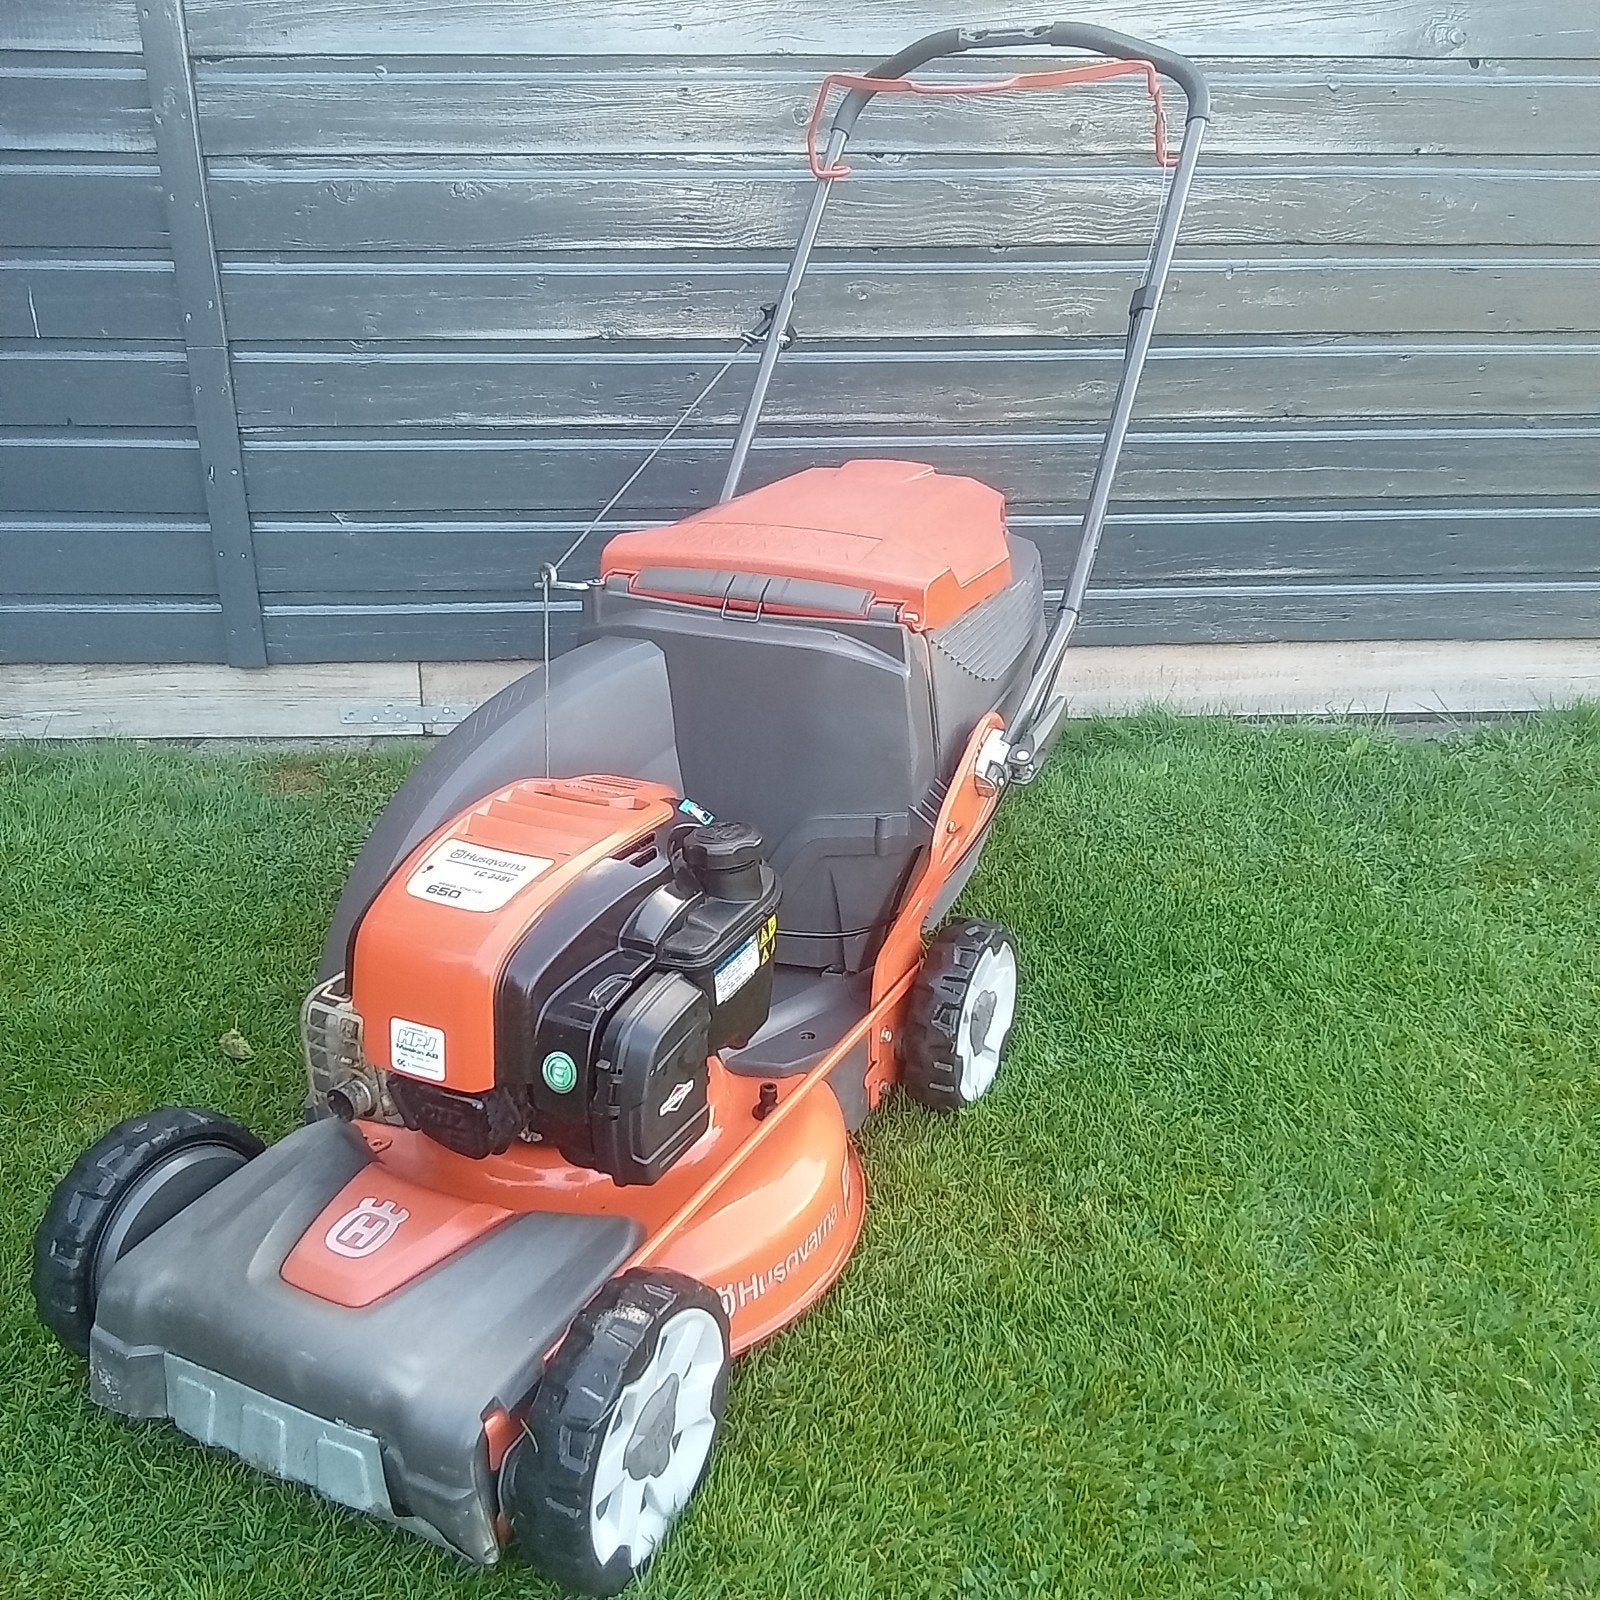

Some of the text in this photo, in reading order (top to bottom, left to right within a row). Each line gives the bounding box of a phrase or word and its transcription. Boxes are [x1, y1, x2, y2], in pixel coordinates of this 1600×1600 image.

[464, 851, 527, 872] Husqvarna
[426, 884, 462, 899] 650
[397, 1028, 437, 1052] HPJ
[738, 1202, 838, 1308] Husqvarna
